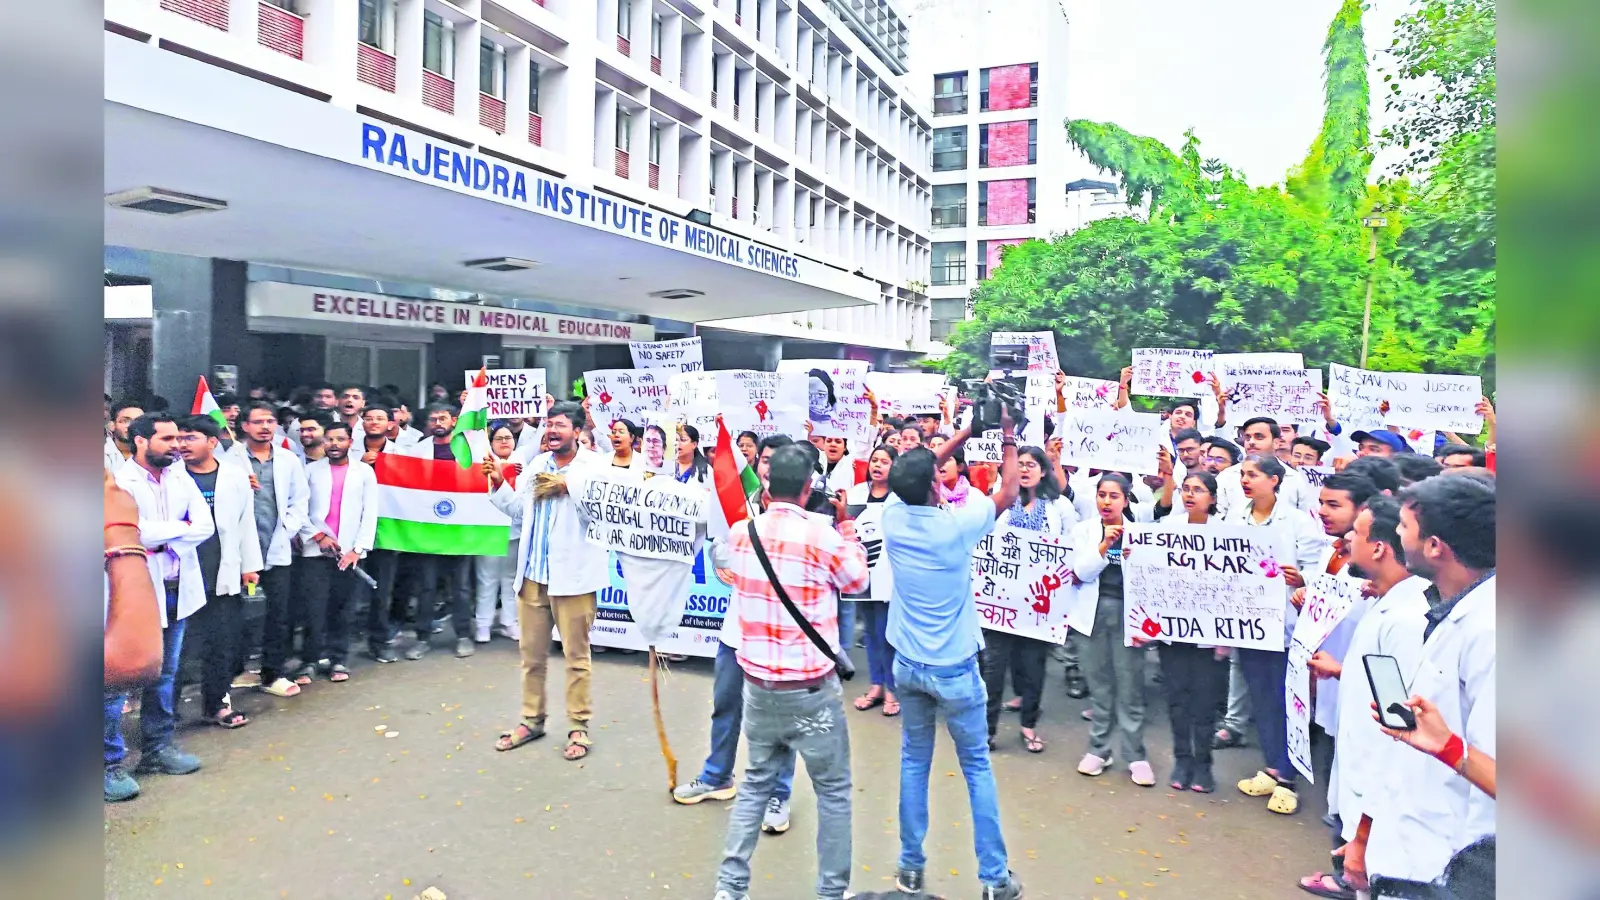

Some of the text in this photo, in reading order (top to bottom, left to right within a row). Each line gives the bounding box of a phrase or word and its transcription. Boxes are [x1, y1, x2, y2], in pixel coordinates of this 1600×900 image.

[362, 122, 527, 202] RAJENDRA
[537, 178, 652, 238] INSTITUTE
[659, 217, 679, 244] OF
[685, 225, 743, 263] MEDICAL
[312, 293, 631, 340] EXCELLENCE IN MEDICAL EDUCATION
[638, 350, 685, 360] NO SAFETY
[681, 361, 702, 373] DUTY
[1333, 366, 1381, 387] WE STAN
[471, 373, 527, 386] OMENS
[1387, 379, 1472, 392] NO JUSTICE
[487, 387, 526, 399] AFETY
[749, 389, 776, 399] BLEED
[1397, 404, 1412, 413] NO
[978, 442, 997, 452] KAR
[608, 483, 642, 506] BENGAL
[606, 504, 643, 528] BENGAL
[650, 512, 690, 537] POLICE
[630, 532, 695, 556] ADMINISTRATION
[1129, 532, 1251, 553] WE STAND WITH
[1028, 541, 1073, 566] पुकार
[1167, 552, 1196, 570] RG
[1204, 553, 1253, 574] KAR
[692, 618, 704, 626] the
[1160, 616, 1265, 640] JDA RIMS
